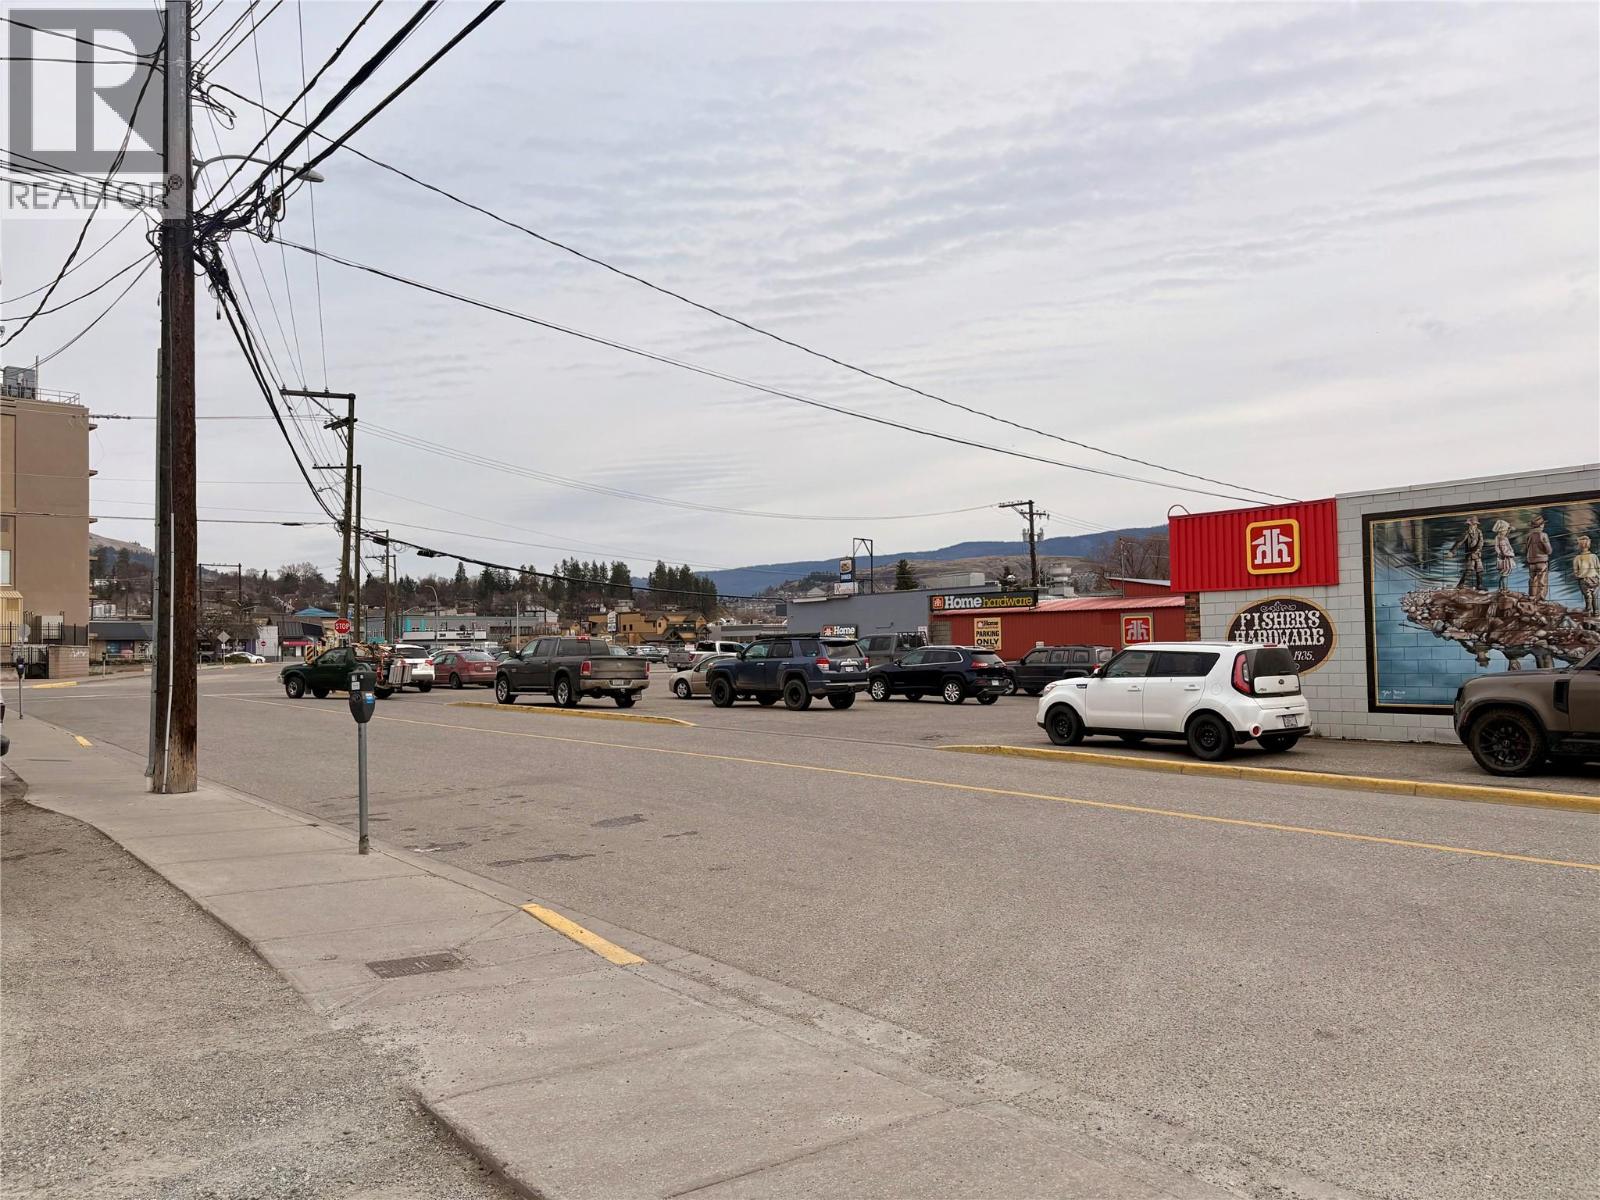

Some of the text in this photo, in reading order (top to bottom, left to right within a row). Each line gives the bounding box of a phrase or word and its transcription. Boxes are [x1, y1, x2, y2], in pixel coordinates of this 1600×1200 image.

[944, 595, 1033, 609] Home hardware
[1240, 609, 1321, 630] FISHER'S
[833, 625, 855, 635] Home
[975, 630, 1000, 638] PARKING
[1234, 628, 1326, 646] HARDWARE
